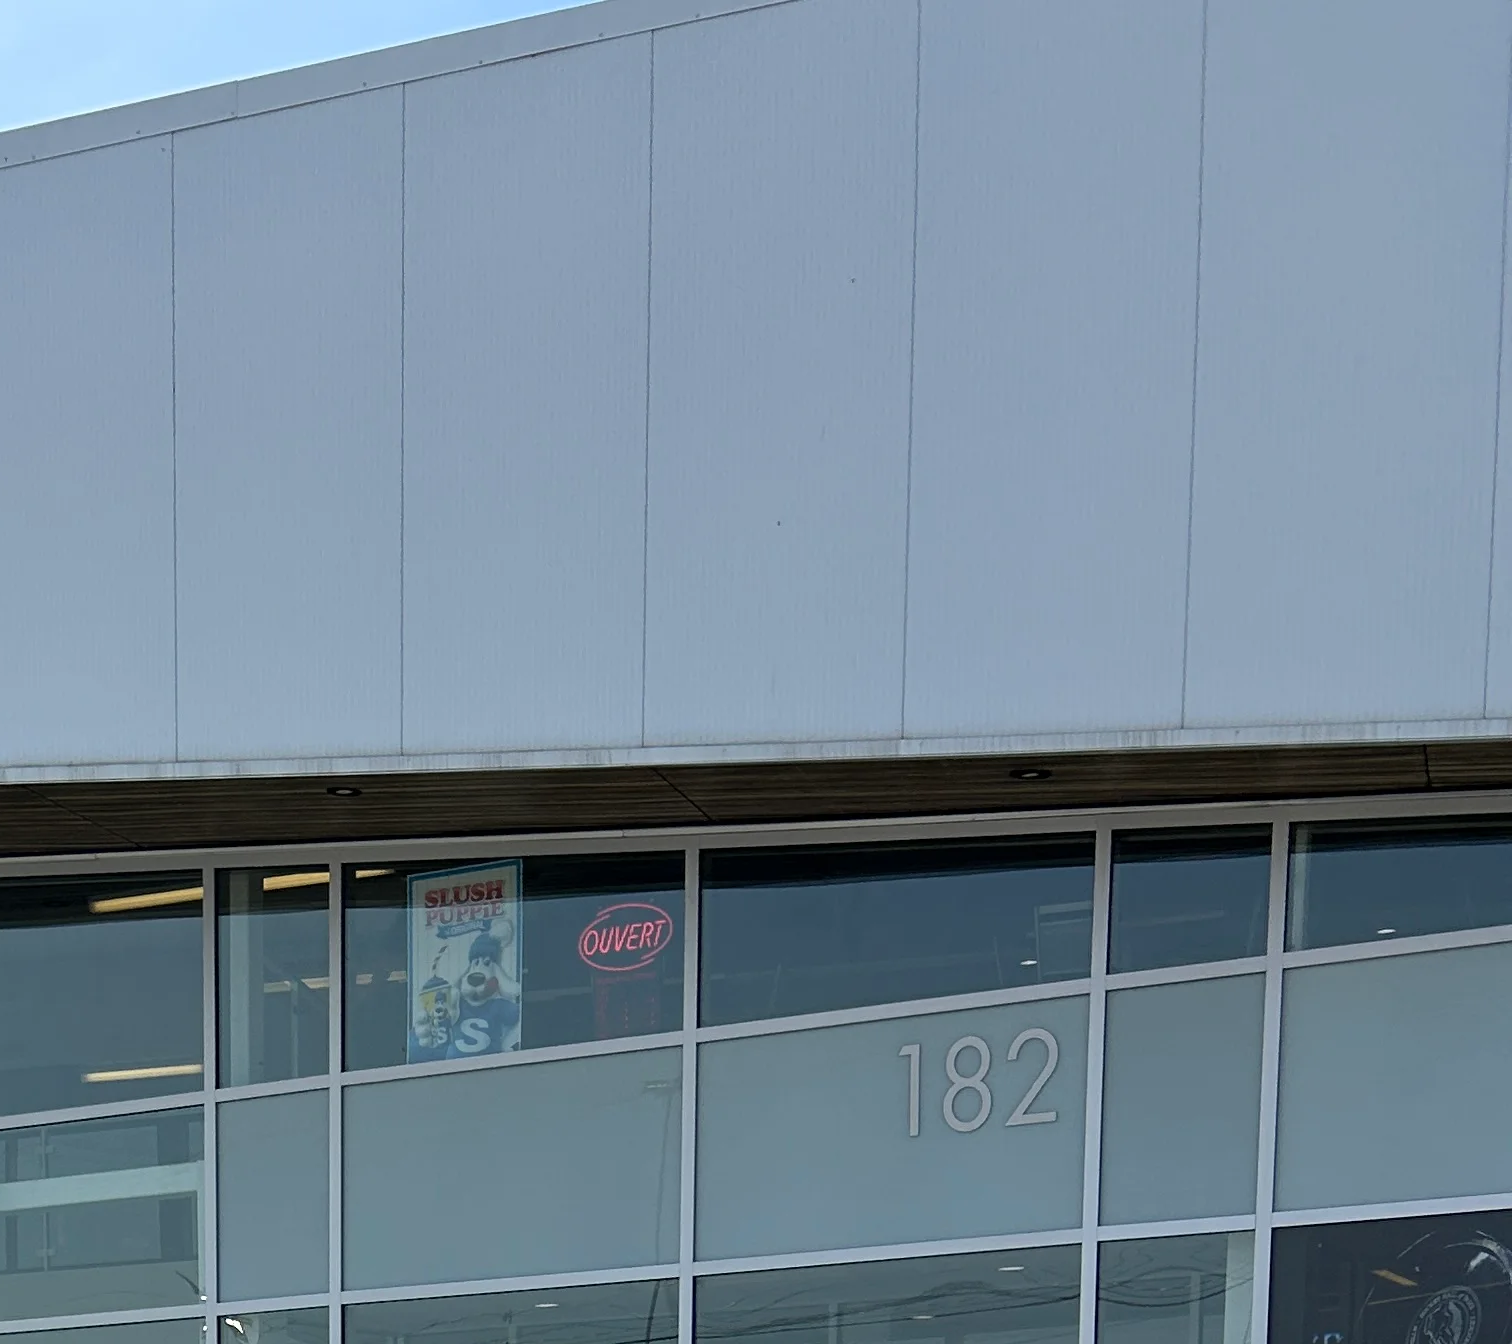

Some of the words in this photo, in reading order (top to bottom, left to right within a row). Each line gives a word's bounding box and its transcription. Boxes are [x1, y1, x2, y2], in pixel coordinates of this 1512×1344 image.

[425, 880, 505, 908] SLUSH
[582, 920, 668, 956] OUVERT
[454, 1018, 491, 1053] S
[898, 1027, 1059, 1137] 182
